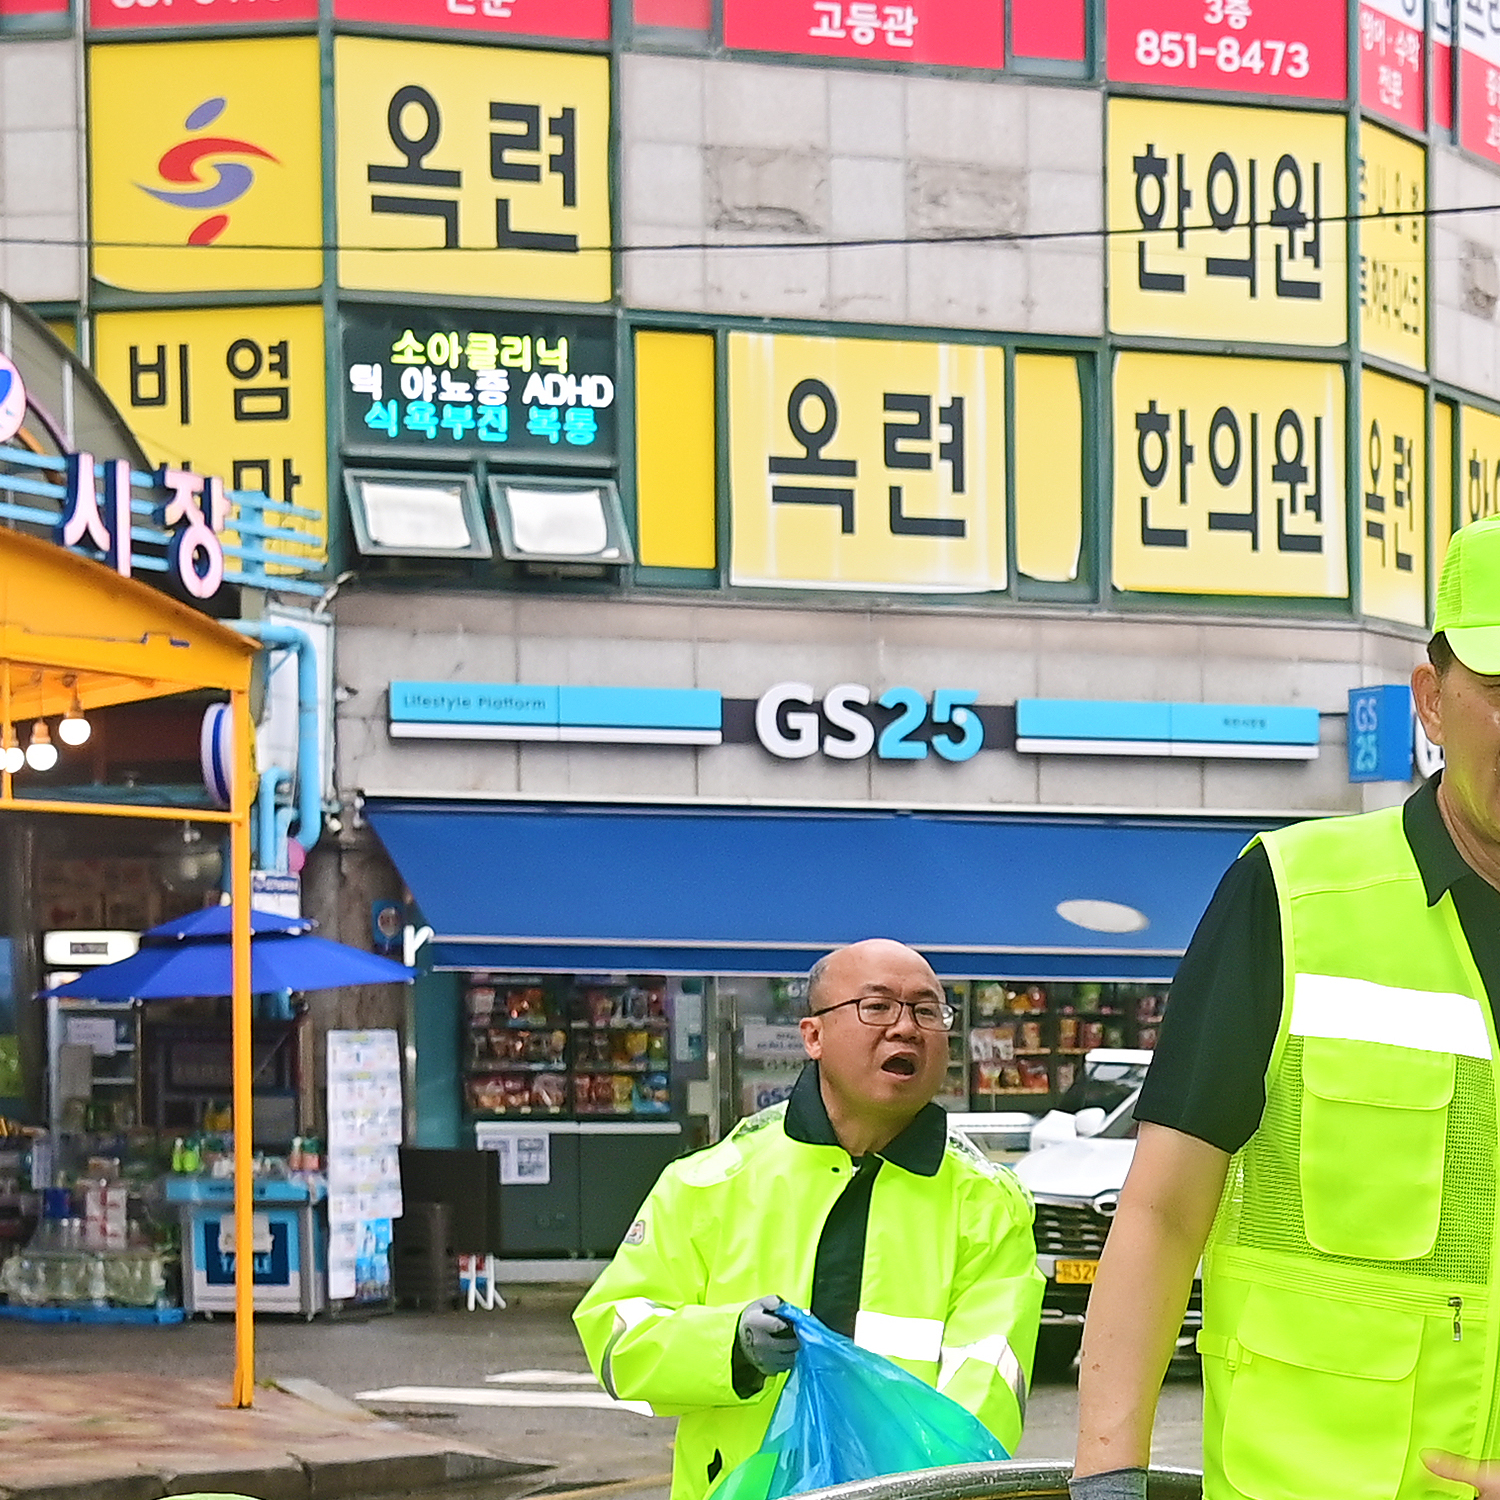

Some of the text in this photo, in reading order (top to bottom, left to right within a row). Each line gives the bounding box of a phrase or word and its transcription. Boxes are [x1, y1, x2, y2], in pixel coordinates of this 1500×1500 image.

[808, 1, 919, 48] 고등관
[1135, 29, 1311, 79] 851-8473
[366, 84, 579, 253] 옥련
[1132, 143, 1323, 301] 한의원
[128, 338, 290, 426] 비염
[390, 329, 569, 374] 소아클리닉
[400, 366, 510, 405] 야뇨증
[522, 372, 614, 408] ADHD
[364, 399, 598, 445] 식욕부진 복통
[768, 377, 967, 539] 옥련
[1133, 399, 1325, 554] 한의원
[60, 451, 232, 599] 시장
[1363, 417, 1414, 573] 옥련
[403, 694, 546, 712] Lifestyle Platform
[755, 681, 985, 762] GS25
[1355, 698, 1378, 732] GS
[1356, 735, 1378, 772] 25
